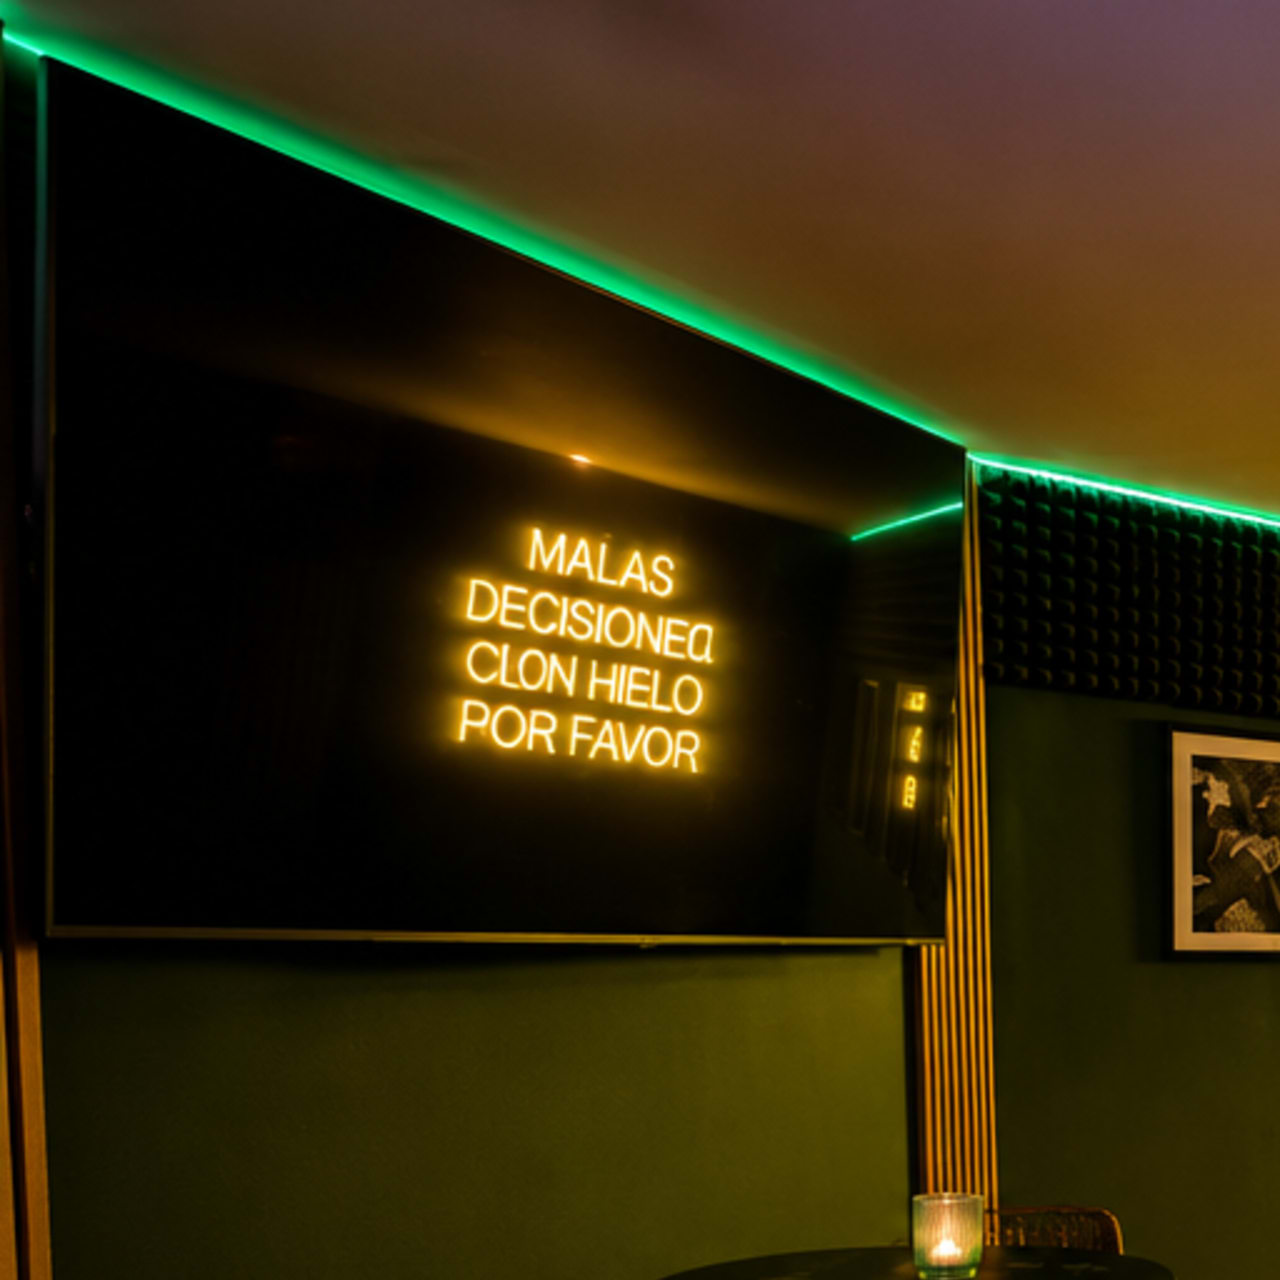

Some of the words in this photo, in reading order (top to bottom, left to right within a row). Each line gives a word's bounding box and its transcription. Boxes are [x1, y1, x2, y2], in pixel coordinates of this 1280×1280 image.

[527, 527, 676, 599] MALAS
[465, 640, 579, 698] CLON
[587, 659, 704, 717] HIELO
[457, 698, 557, 756] POR
[567, 714, 701, 775] FAVOR
